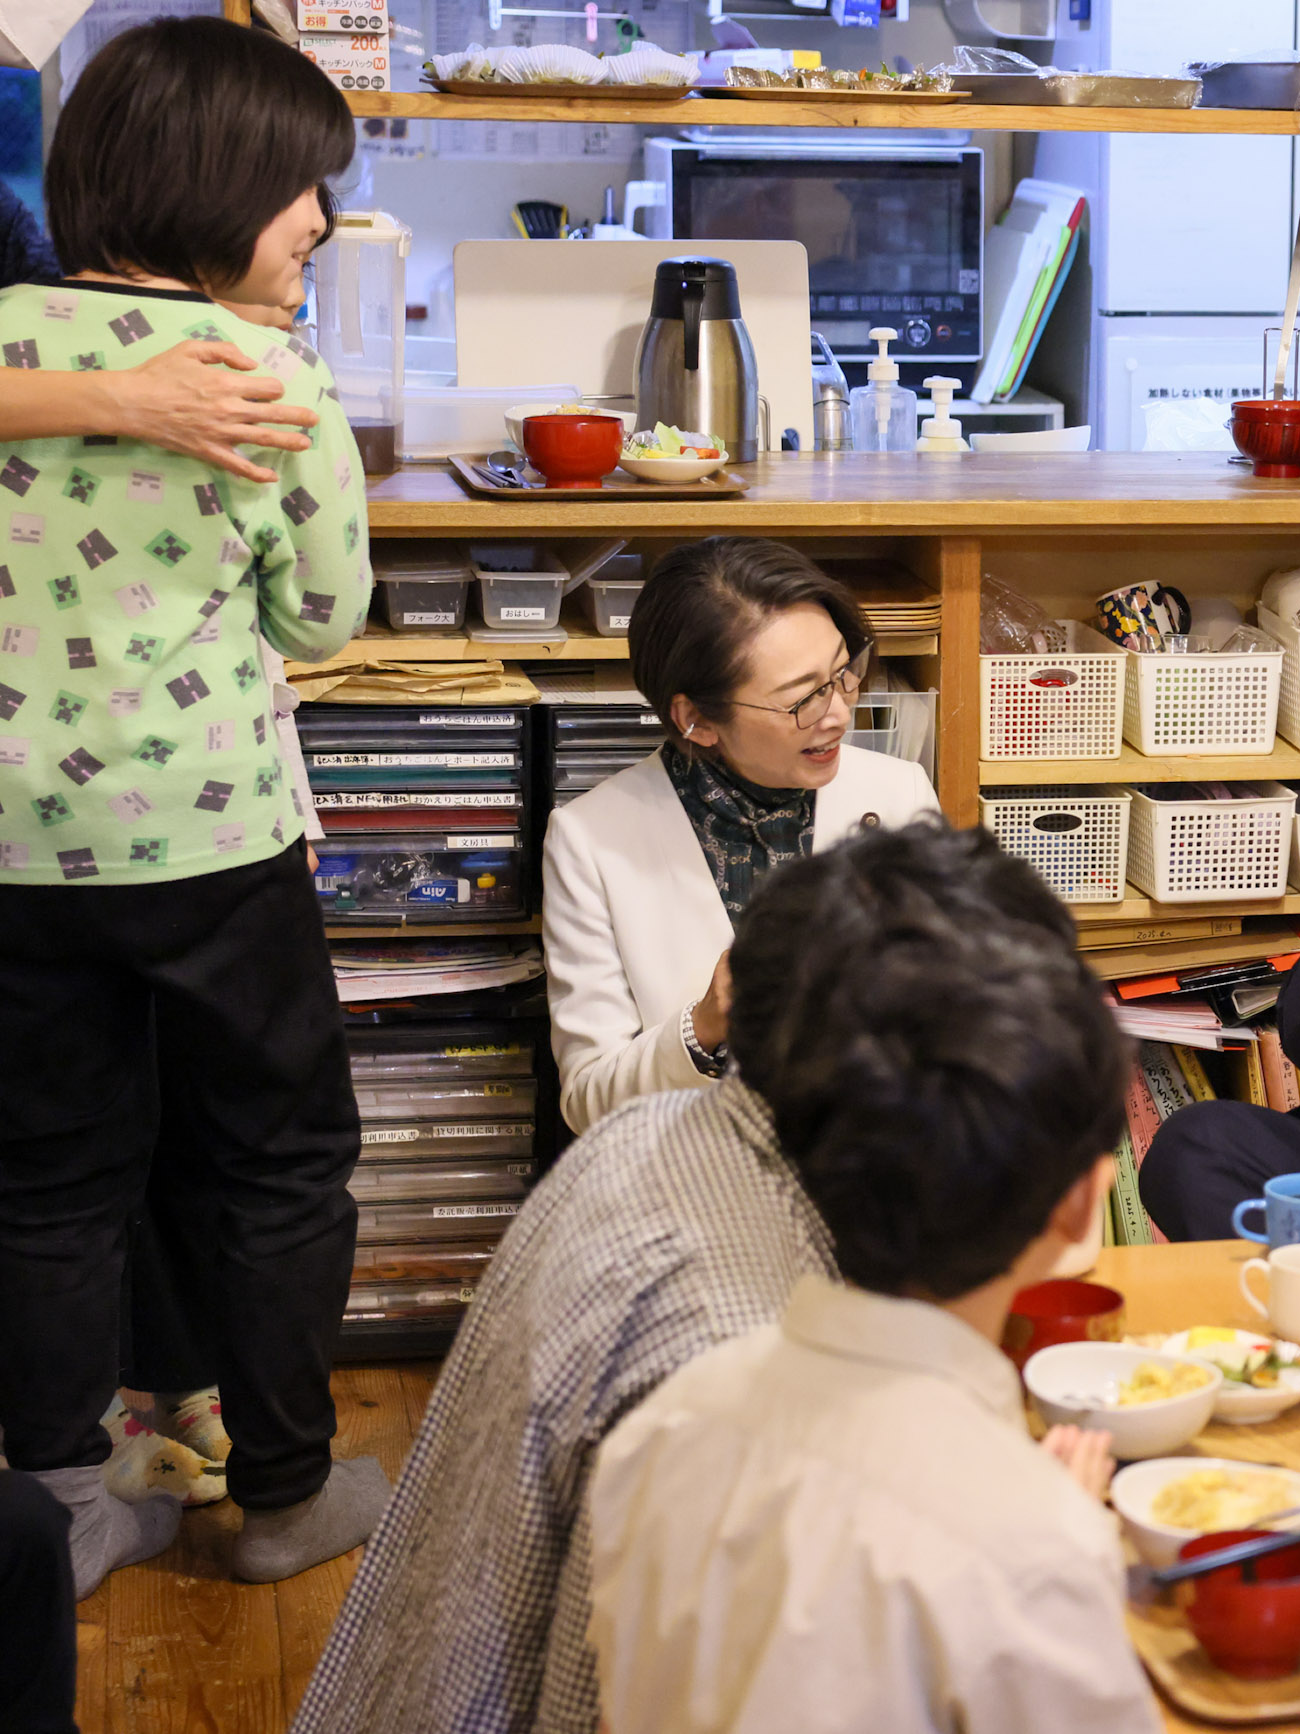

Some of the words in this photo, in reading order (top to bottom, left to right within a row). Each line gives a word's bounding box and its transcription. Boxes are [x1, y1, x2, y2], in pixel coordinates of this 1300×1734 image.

[305, 16, 326, 27] お得
[351, 35, 379, 51] 200
[319, 59, 373, 68] キッチンパック
[407, 614, 450, 623] フォーク大
[422, 714, 512, 724] おうちごはん申込済
[383, 755, 511, 765] おうちごはんレポート記入済
[413, 795, 512, 806] おかえりごはん申込書
[460, 838, 489, 847] 文房具
[421, 886, 447, 897] Ain
